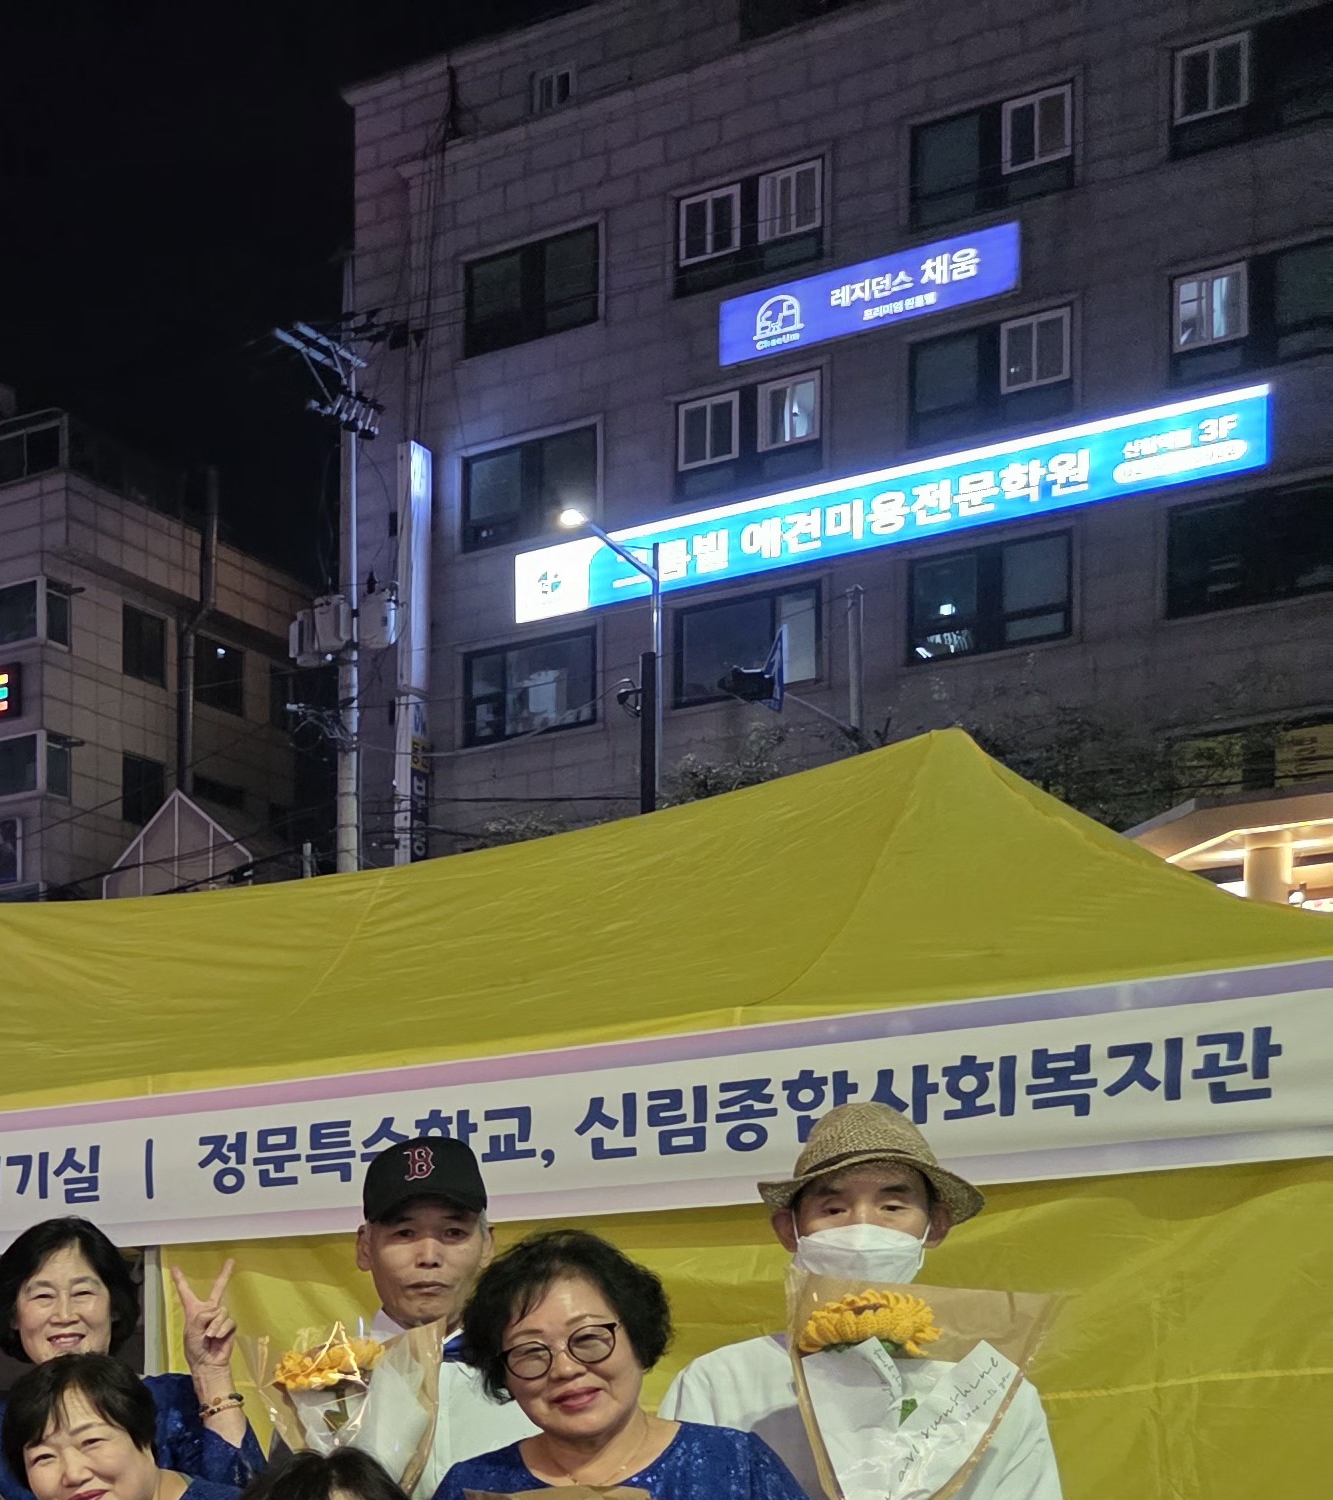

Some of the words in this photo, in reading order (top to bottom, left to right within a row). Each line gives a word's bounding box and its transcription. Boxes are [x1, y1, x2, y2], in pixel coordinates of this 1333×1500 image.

[830, 271, 914, 307] 레지던스
[920, 247, 980, 285] 채움
[1197, 413, 1239, 443] 3F
[740, 447, 1091, 560] 애견미용전문학원
[574, 1026, 1283, 1161] 신림종합사회복지관
[403, 1146, 436, 1181] B
[920, 1356, 999, 1440] sunshine
